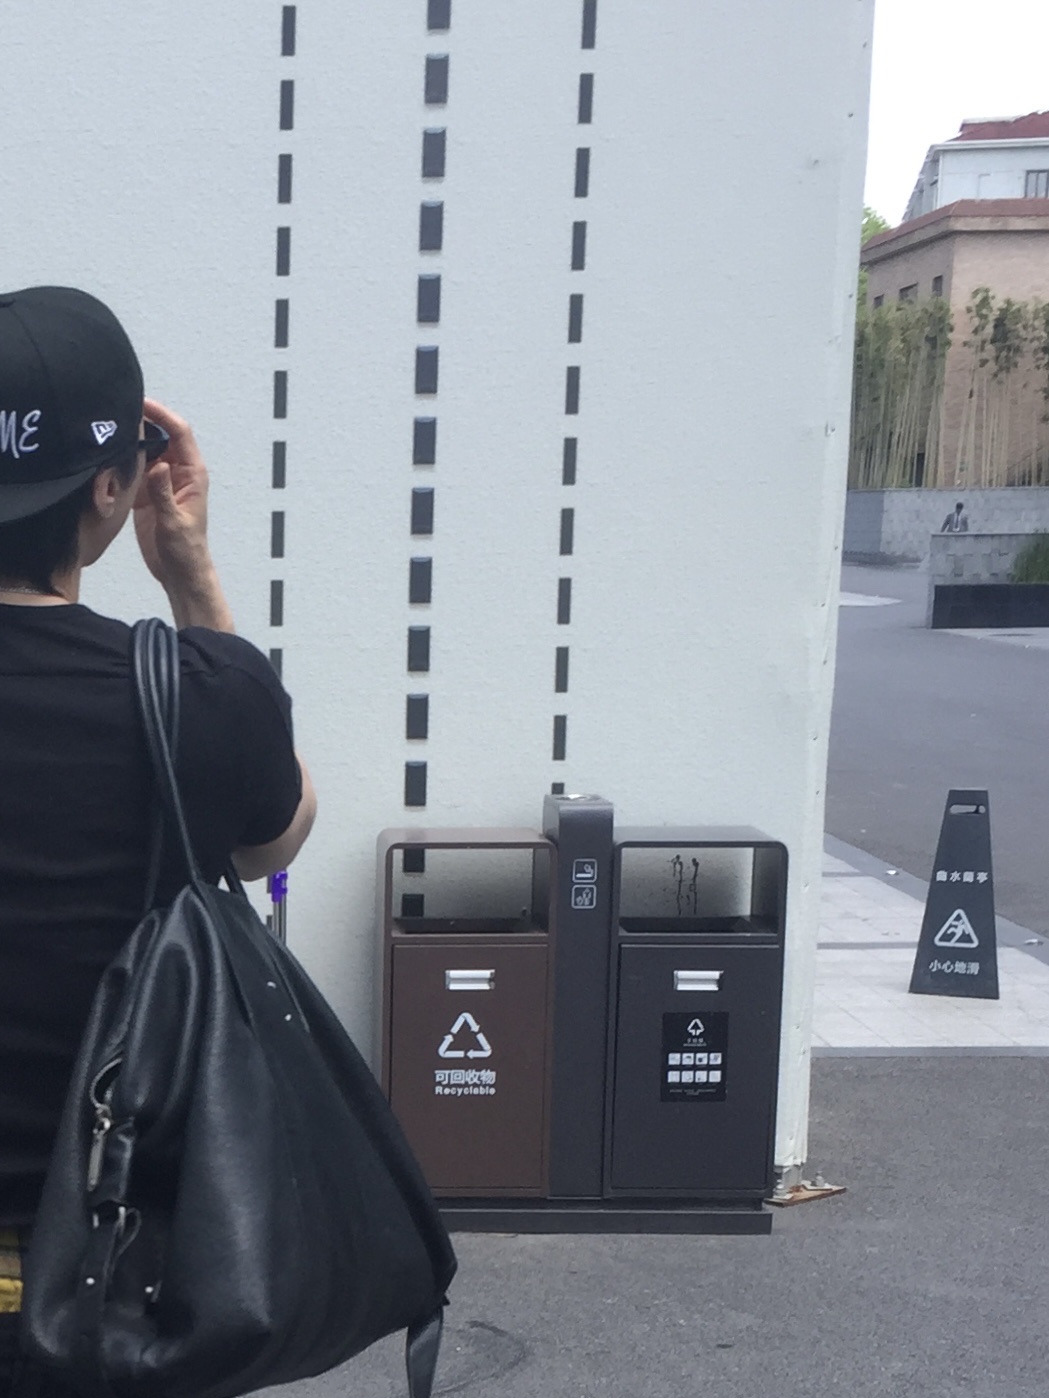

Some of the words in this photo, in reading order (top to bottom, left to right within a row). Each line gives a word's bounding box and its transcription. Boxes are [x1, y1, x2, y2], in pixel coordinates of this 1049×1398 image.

[929, 960, 980, 976] 小心地滑
[434, 1069, 497, 1085] 可回收物
[435, 1086, 497, 1097] Recyclable
